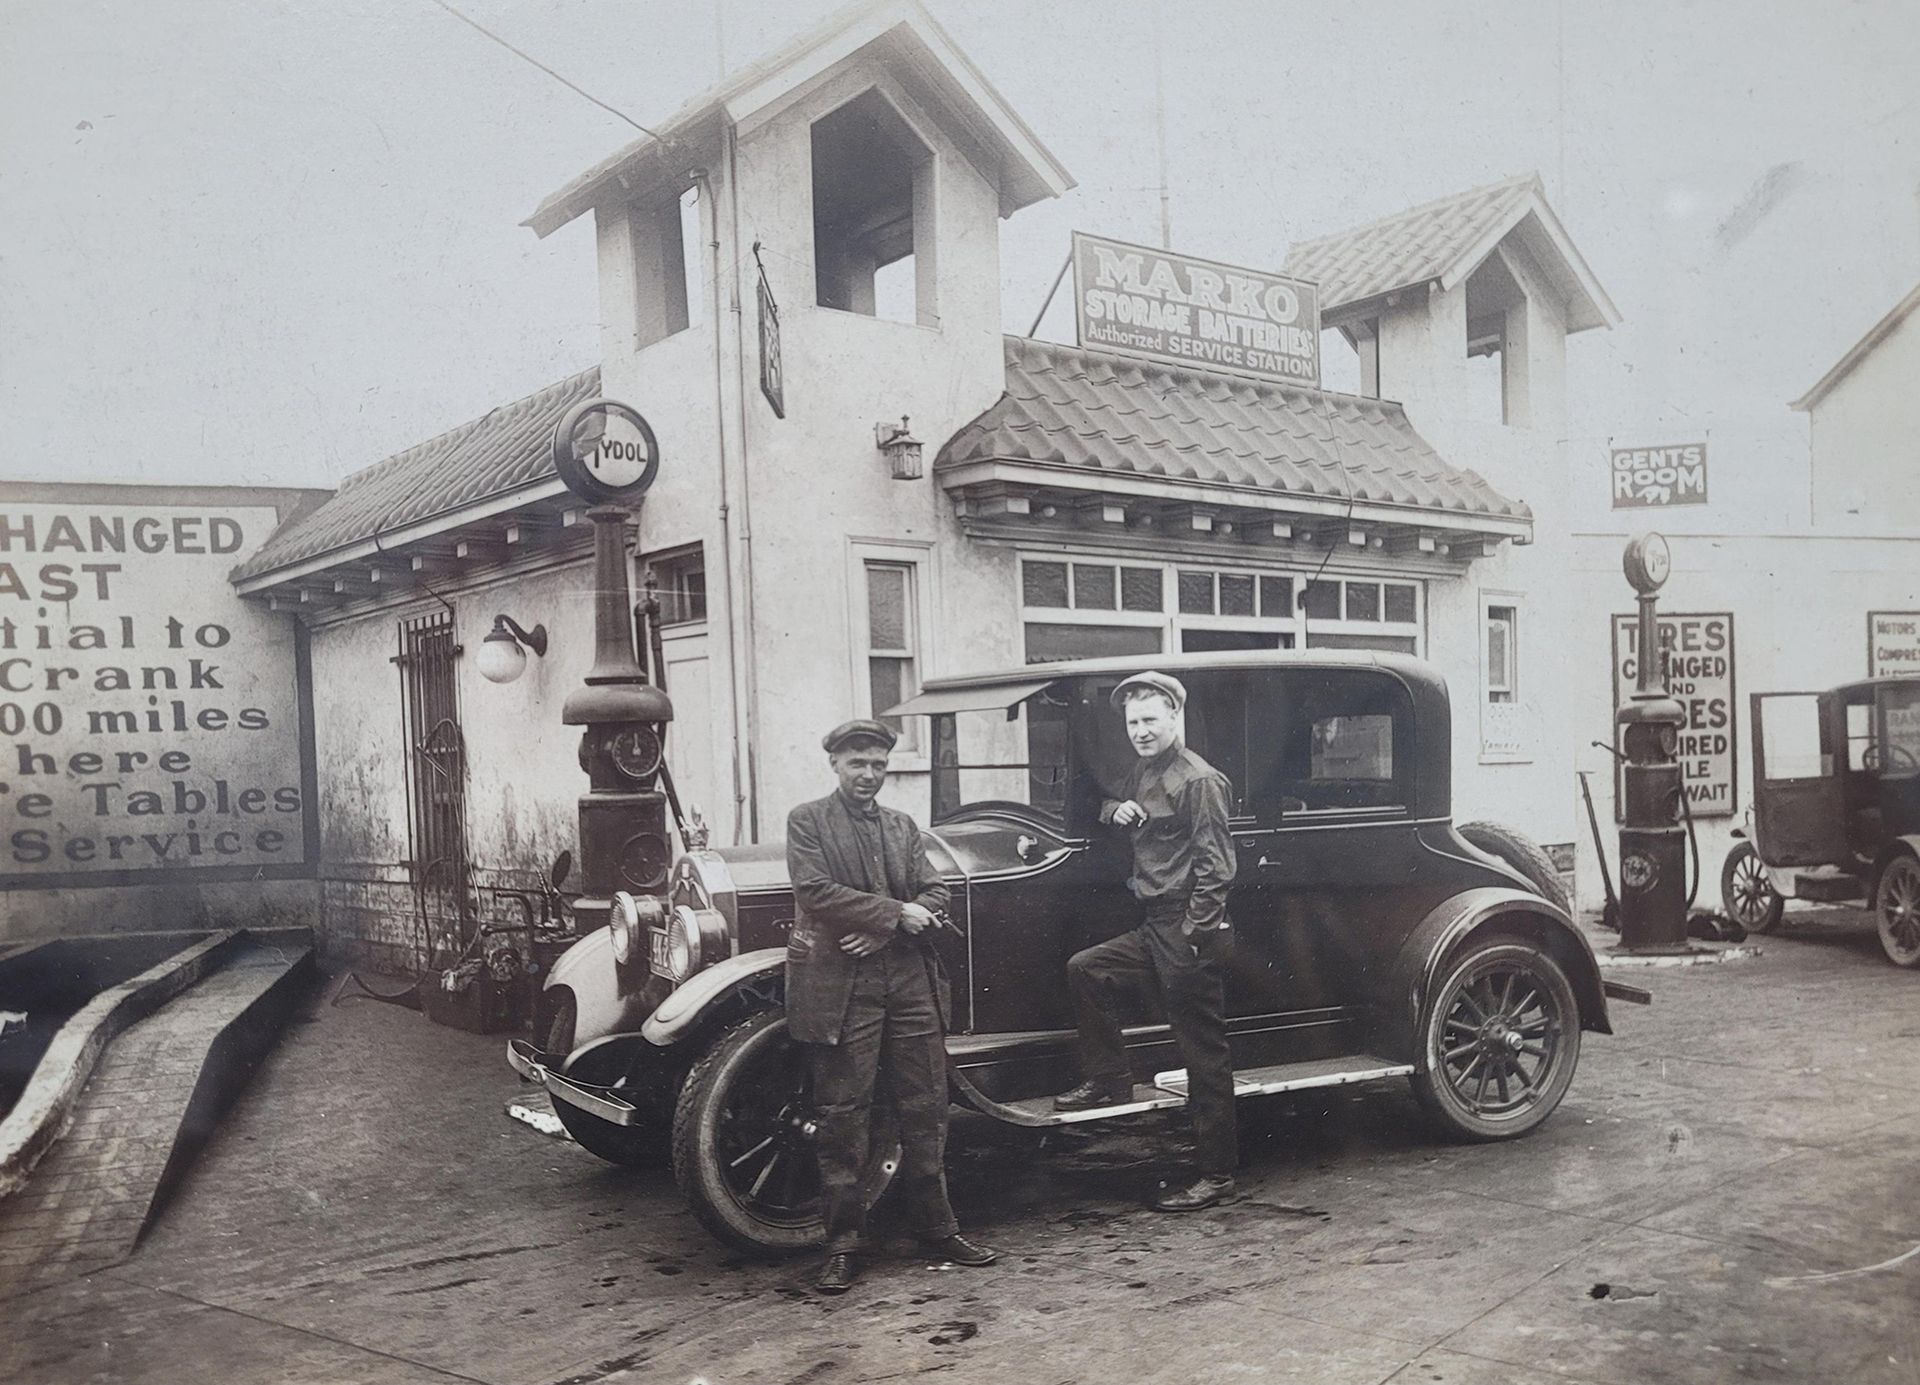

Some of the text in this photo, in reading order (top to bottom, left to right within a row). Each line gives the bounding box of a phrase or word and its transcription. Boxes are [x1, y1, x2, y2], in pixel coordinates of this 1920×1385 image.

[1094, 247, 1299, 324] MARKO
[1085, 289, 1314, 359] STORAGE BATTERIES
[1088, 321, 1313, 378] Authorized SERVICE STATION
[1614, 448, 1702, 470] GENTS
[1614, 465, 1704, 499] ROOM
[0, 514, 243, 555] HANGED
[0, 562, 122, 601] AST
[0, 606, 231, 649] tial to
[1621, 621, 1726, 653] TRES
[1622, 656, 1727, 679] CNGED
[1877, 646, 1920, 661] COMPRE
[0, 657, 224, 692] Crank
[1669, 683, 1696, 695] ND
[87, 694, 270, 735] miles
[16, 744, 191, 776] here
[1673, 735, 1727, 757] IRED
[0, 779, 300, 818] e Tables
[1684, 784, 1728, 802] WAIT
[10, 819, 284, 863] Service
